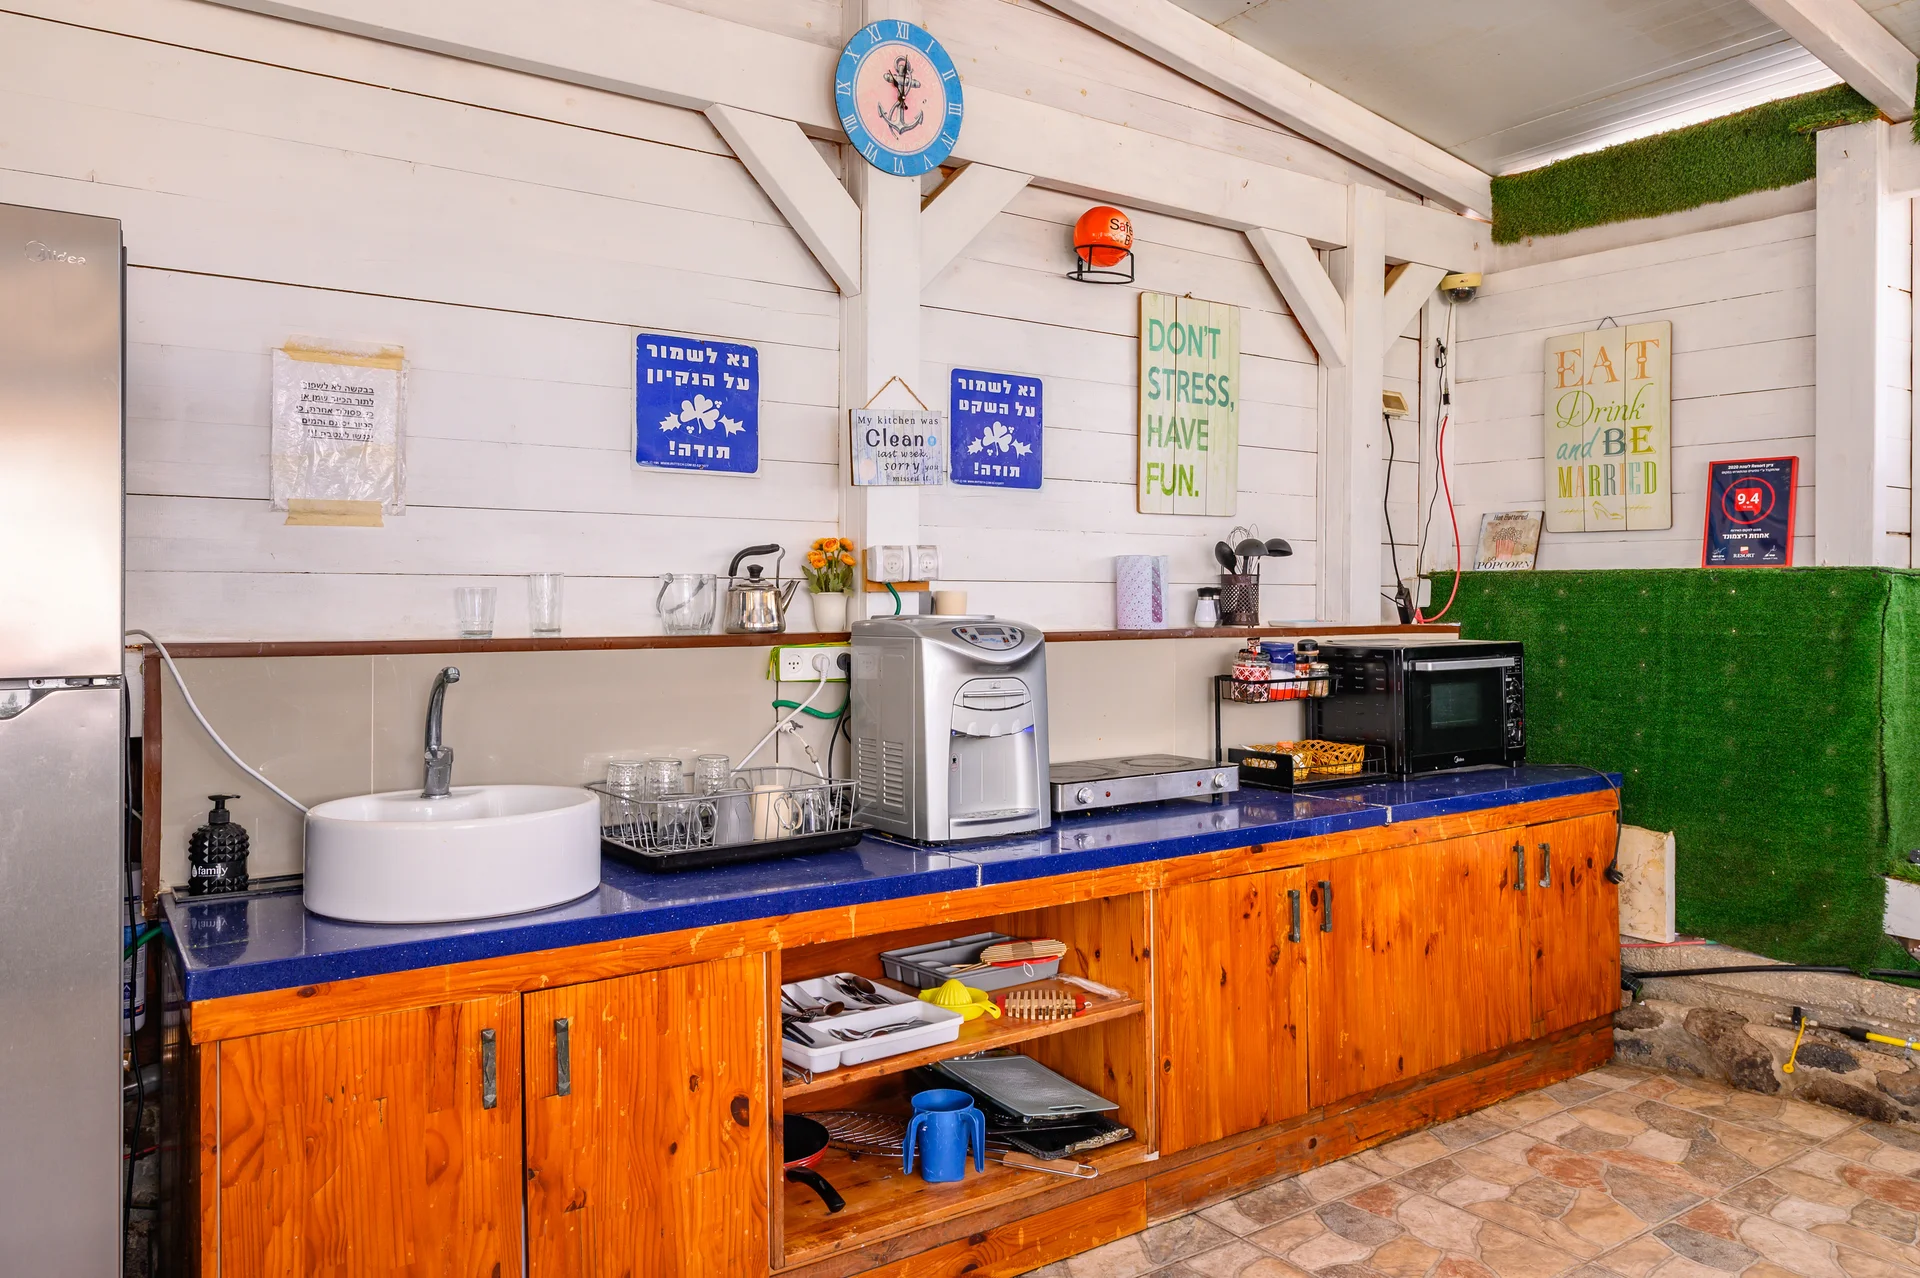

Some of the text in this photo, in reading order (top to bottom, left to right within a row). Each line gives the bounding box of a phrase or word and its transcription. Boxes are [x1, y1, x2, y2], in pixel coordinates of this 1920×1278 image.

[866, 24, 882, 44] XI
[896, 22, 910, 40] XII
[845, 46, 860, 64] X
[925, 40, 935, 54] I
[942, 68, 956, 82] II
[837, 80, 850, 96] IX
[948, 102, 962, 116] III
[843, 114, 859, 134] VIII
[941, 131, 955, 150] IV
[864, 142, 878, 163] VII
[894, 157, 905, 174] VI
[923, 154, 934, 170] V
[1149, 318, 1221, 360] DON'T
[646, 344, 750, 368] נא לשמור
[1553, 339, 1660, 389] EAT
[647, 368, 749, 391] על הנקיון
[958, 378, 1036, 397] נא לשמור
[344, 385, 374, 394] בבקשה
[1148, 366, 1234, 412] STRESS,
[356, 398, 374, 406] לתוך
[959, 399, 1035, 417] על השקט
[1556, 383, 1654, 428] Drink
[858, 416, 872, 426] My
[878, 416, 915, 424] kitchen
[866, 428, 924, 447] Clean
[1147, 414, 1209, 451] HAVE
[669, 440, 730, 459] תודה!
[1556, 425, 1656, 461] and BE
[877, 449, 928, 458] last week.
[884, 462, 920, 474] sorry
[974, 462, 1020, 477] תודה!
[1146, 462, 1199, 497] FUN.
[1558, 461, 1657, 498] MARRIED
[1737, 493, 1759, 504] 9.4
[1477, 561, 1532, 569] POPCORN
[198, 863, 228, 876] family
